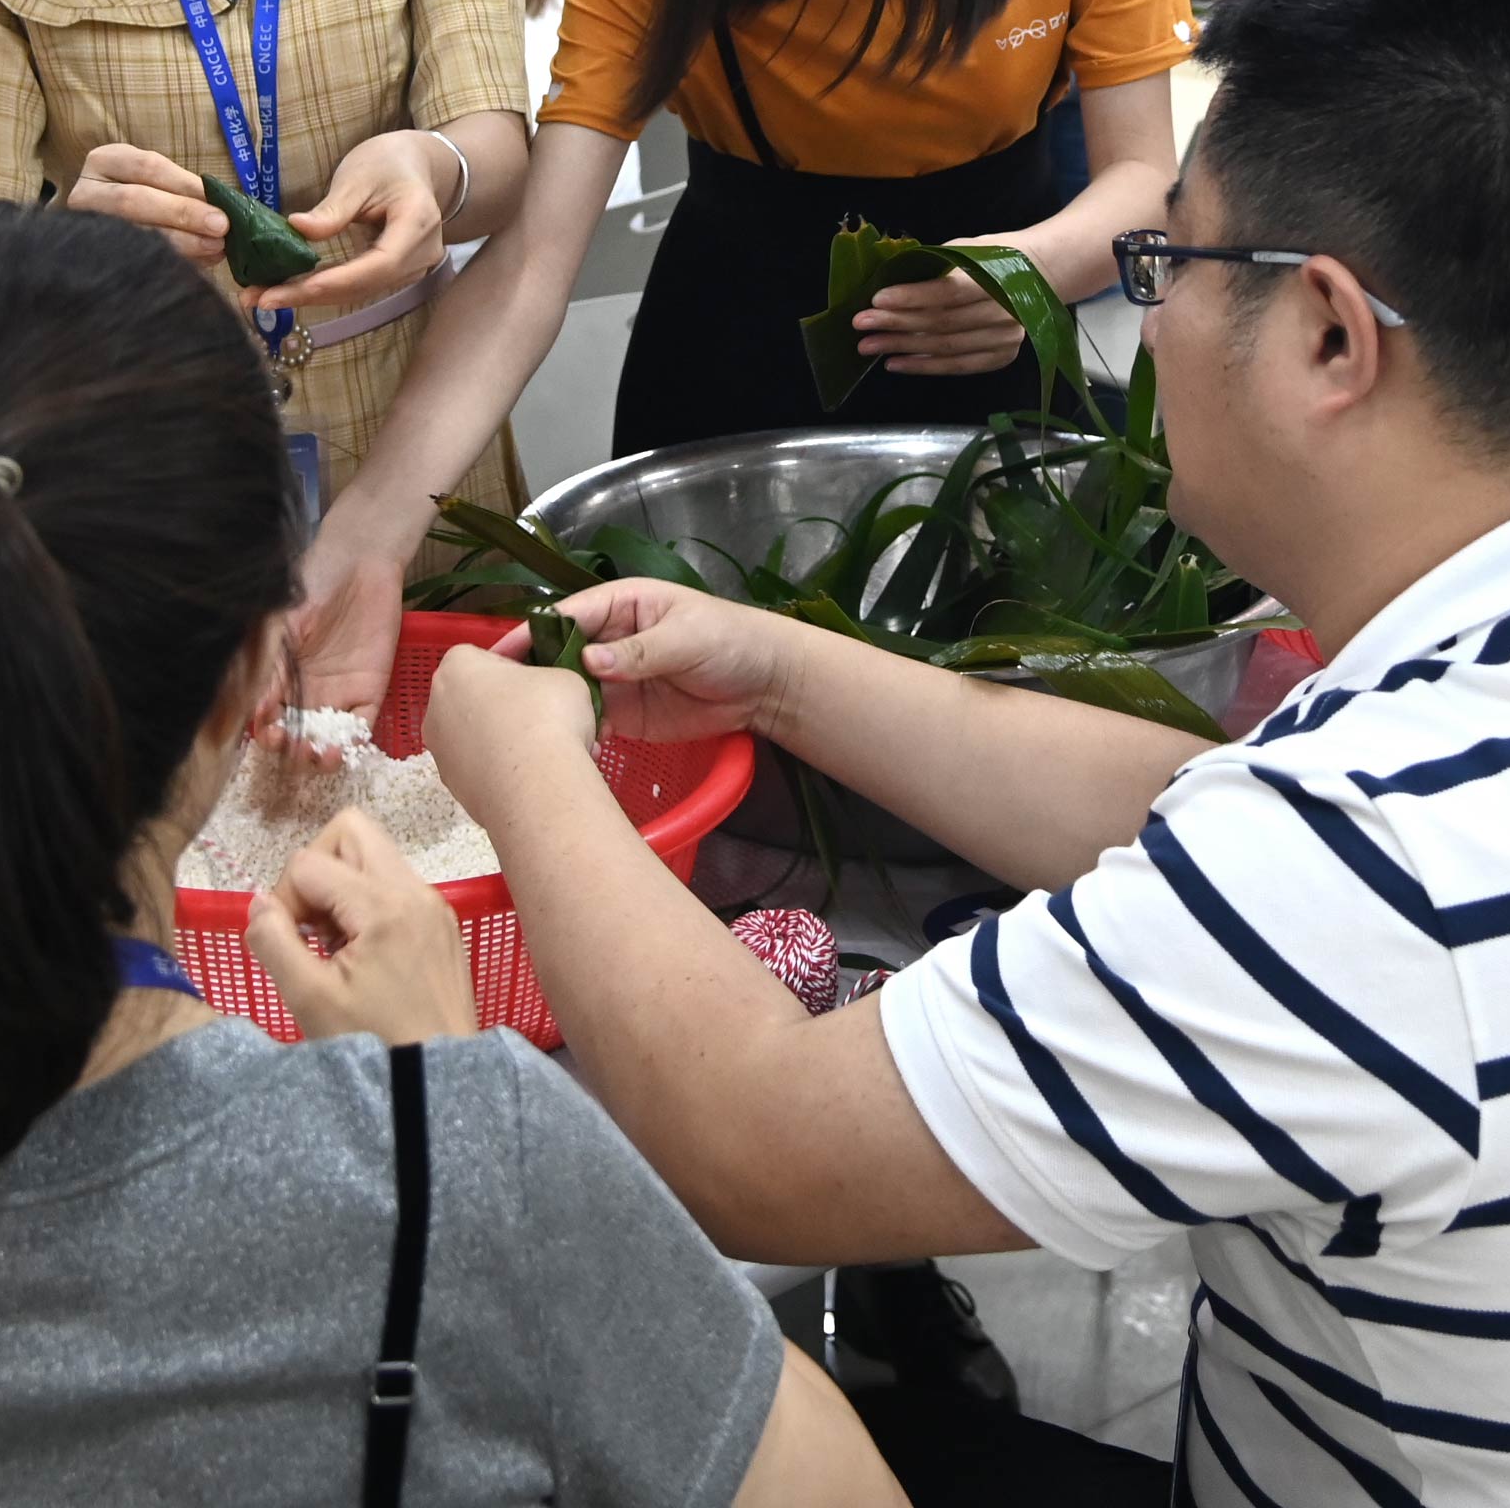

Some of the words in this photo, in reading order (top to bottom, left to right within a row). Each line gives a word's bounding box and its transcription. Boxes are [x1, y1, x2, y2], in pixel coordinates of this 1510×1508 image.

[202, 37, 228, 86] CNCEC
[258, 24, 273, 74] CNCEC
[224, 105, 251, 162] 中国化学
[245, 171, 260, 199] CEC
[262, 164, 275, 211] NCEC
